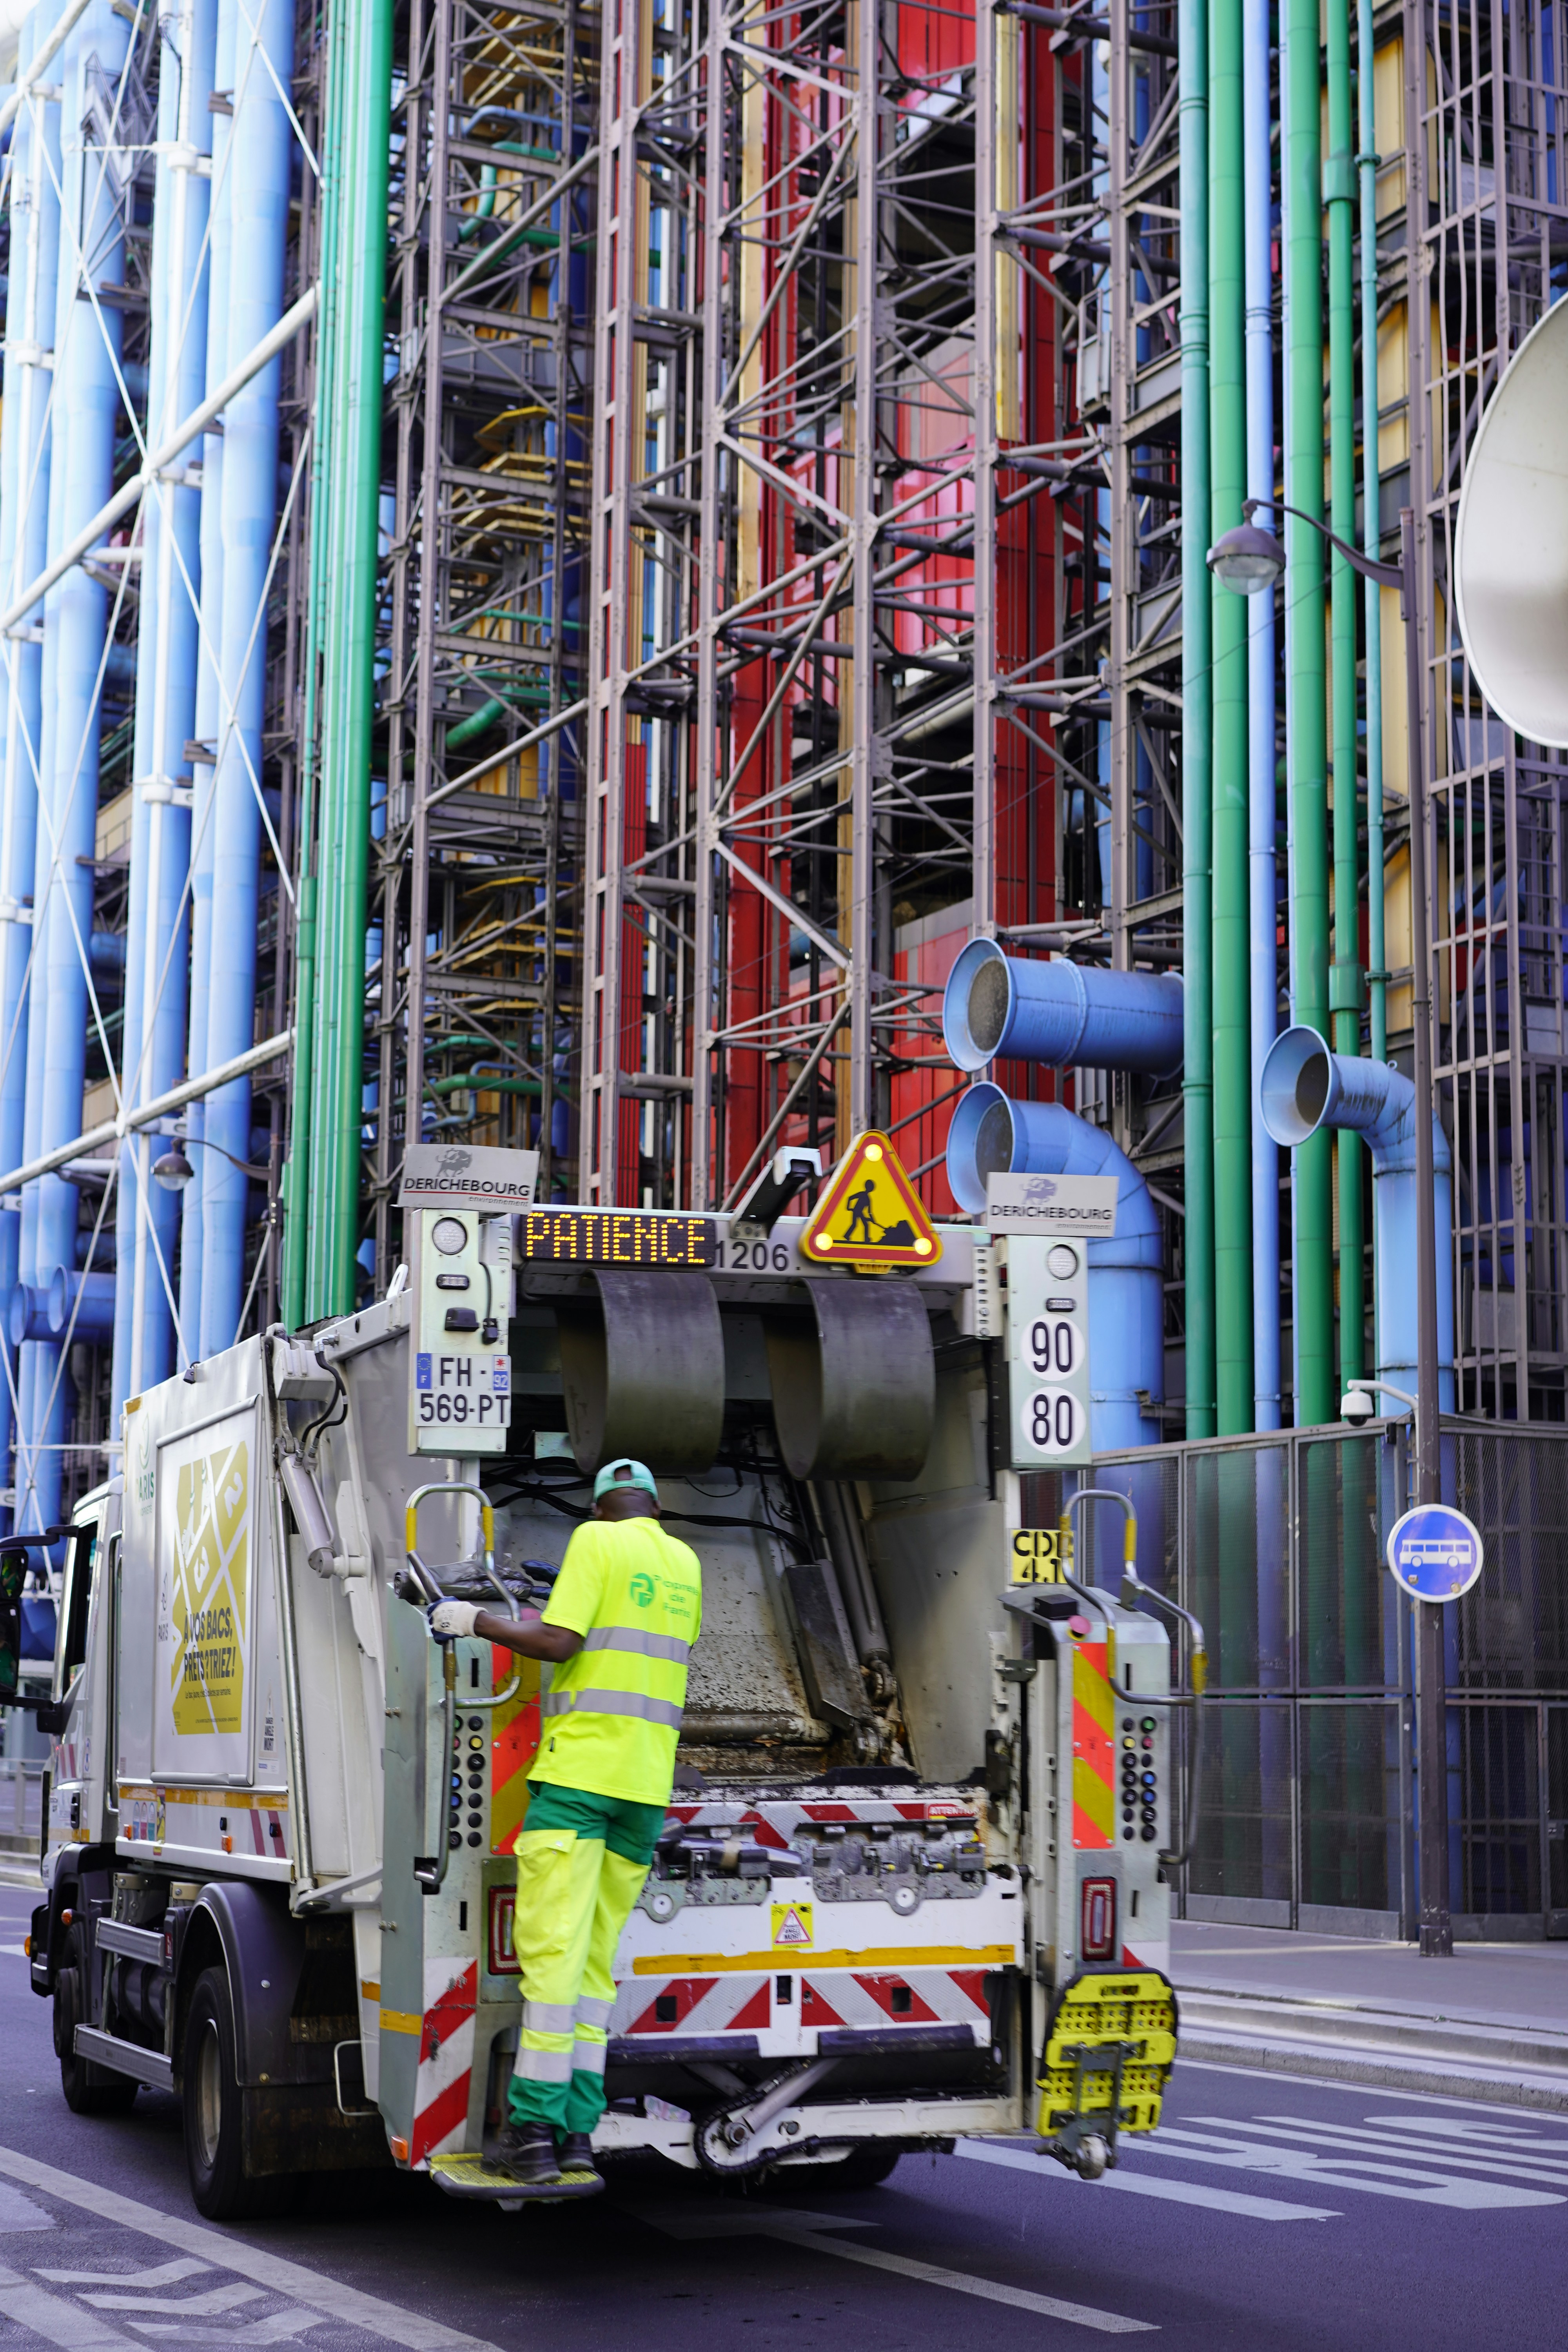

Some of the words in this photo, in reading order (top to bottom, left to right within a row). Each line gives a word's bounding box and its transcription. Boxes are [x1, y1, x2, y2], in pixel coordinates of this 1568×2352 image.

[404, 1178, 530, 1196] DERICHEBOURG
[468, 1196, 529, 1207] environnement
[991, 1205, 1113, 1220] DERICHEBOURG
[526, 1212, 705, 1263] PATIENCE
[1032, 1321, 1071, 1372] 90
[420, 1375, 427, 1384] F
[494, 1374, 508, 1388] 92
[420, 1393, 510, 1424] 569-PT
[1033, 1394, 1072, 1446] 80
[190, 1611, 205, 1642] VOS
[206, 1606, 232, 1642] BACS,
